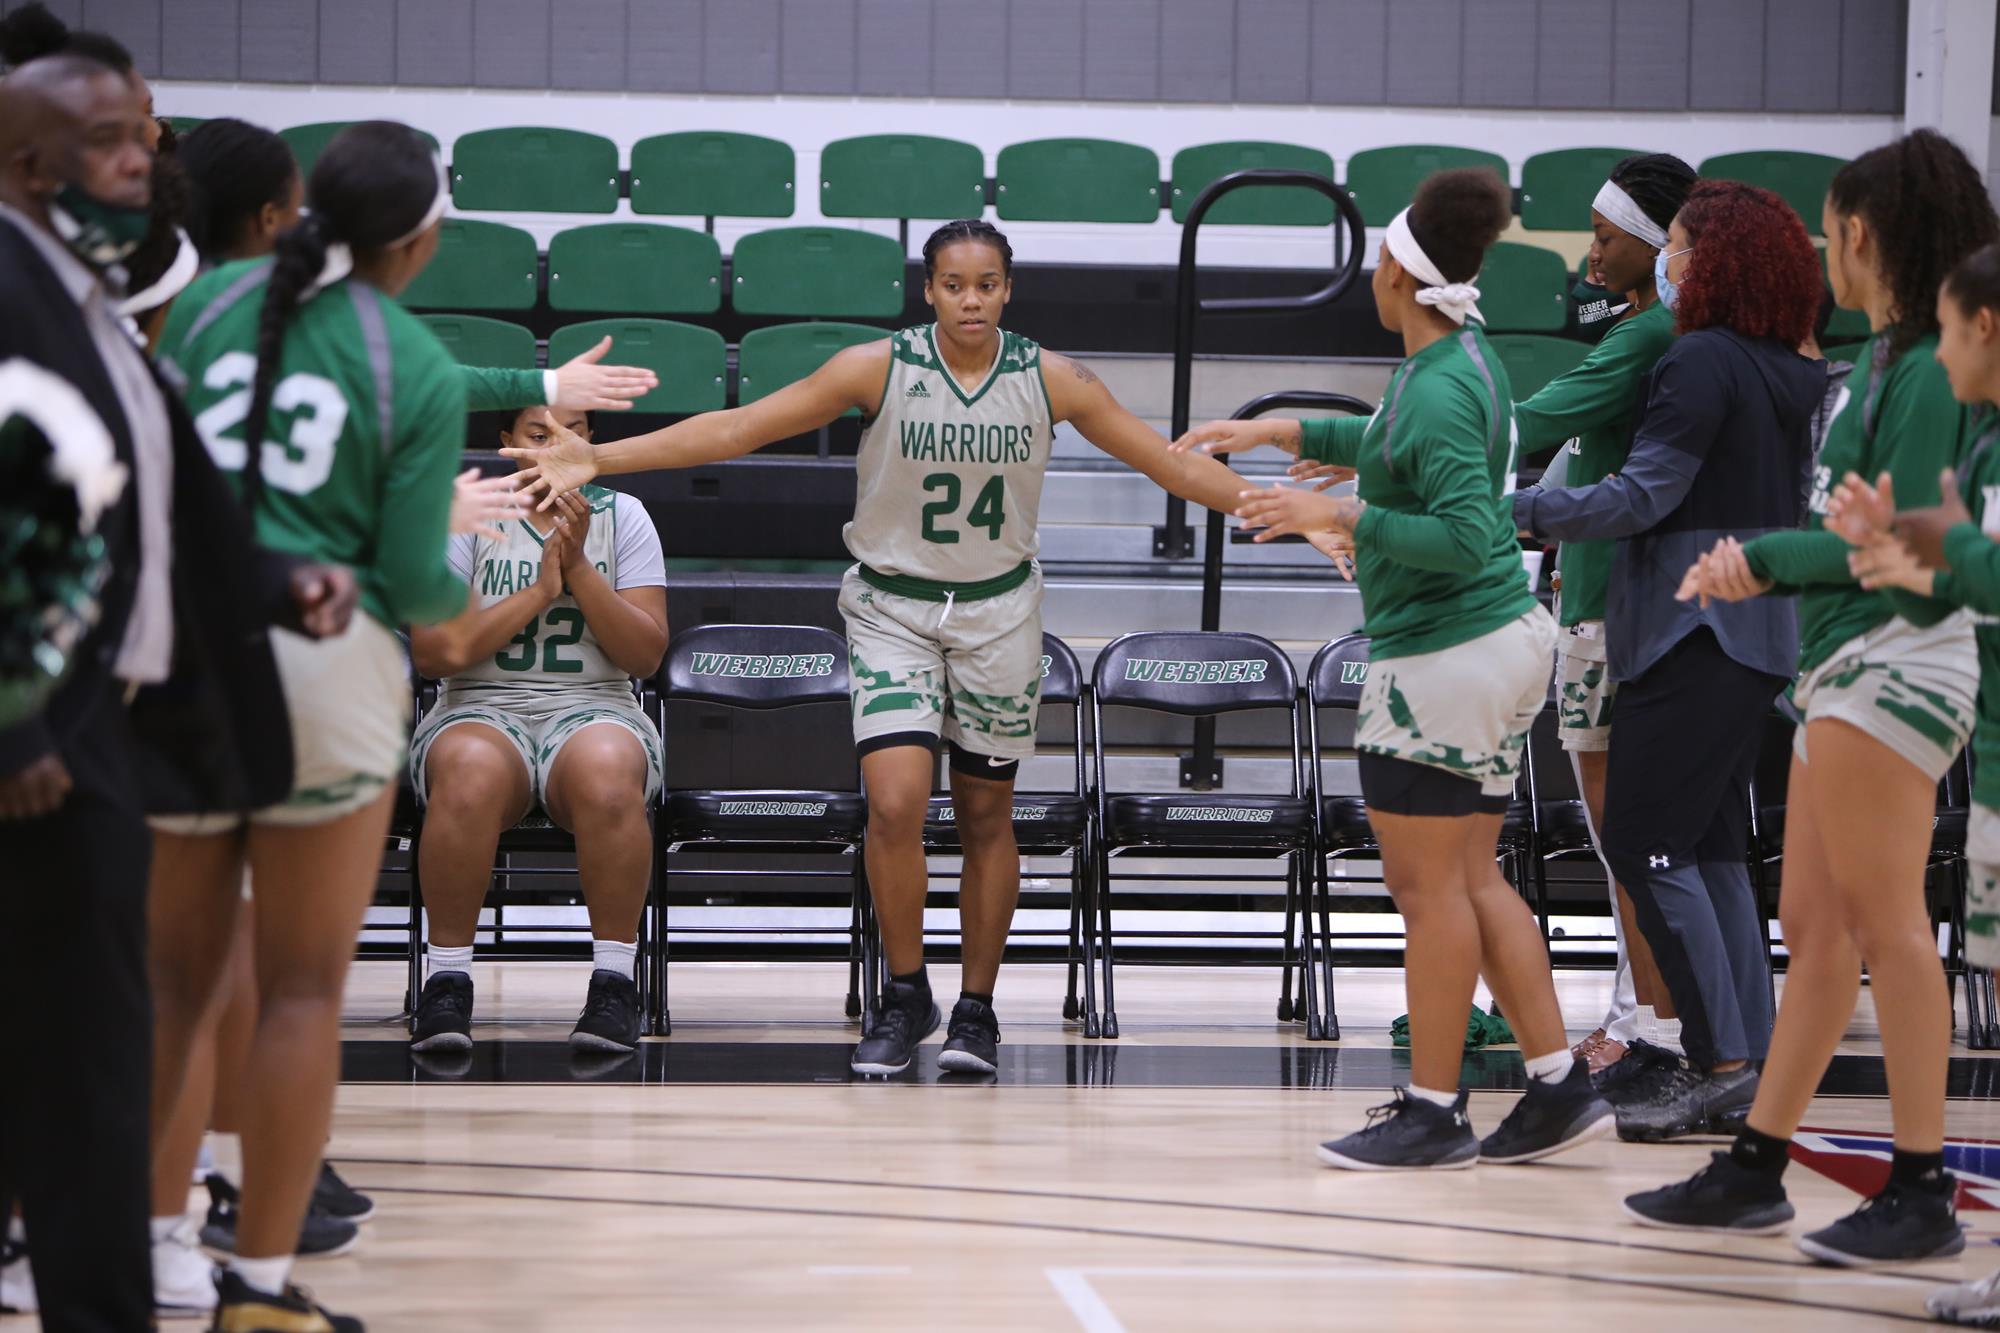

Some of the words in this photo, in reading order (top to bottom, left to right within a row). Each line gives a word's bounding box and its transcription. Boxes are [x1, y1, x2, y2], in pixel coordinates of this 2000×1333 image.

[194, 350, 349, 496] 23
[901, 420, 1032, 463] WARRIORS
[922, 472, 1006, 543] 24
[495, 607, 585, 673] 32
[690, 652, 835, 678] WEBBER
[1125, 658, 1268, 684] WEBBER
[719, 801, 827, 816] WARRIORS
[1166, 807, 1273, 822] WARRIORS
